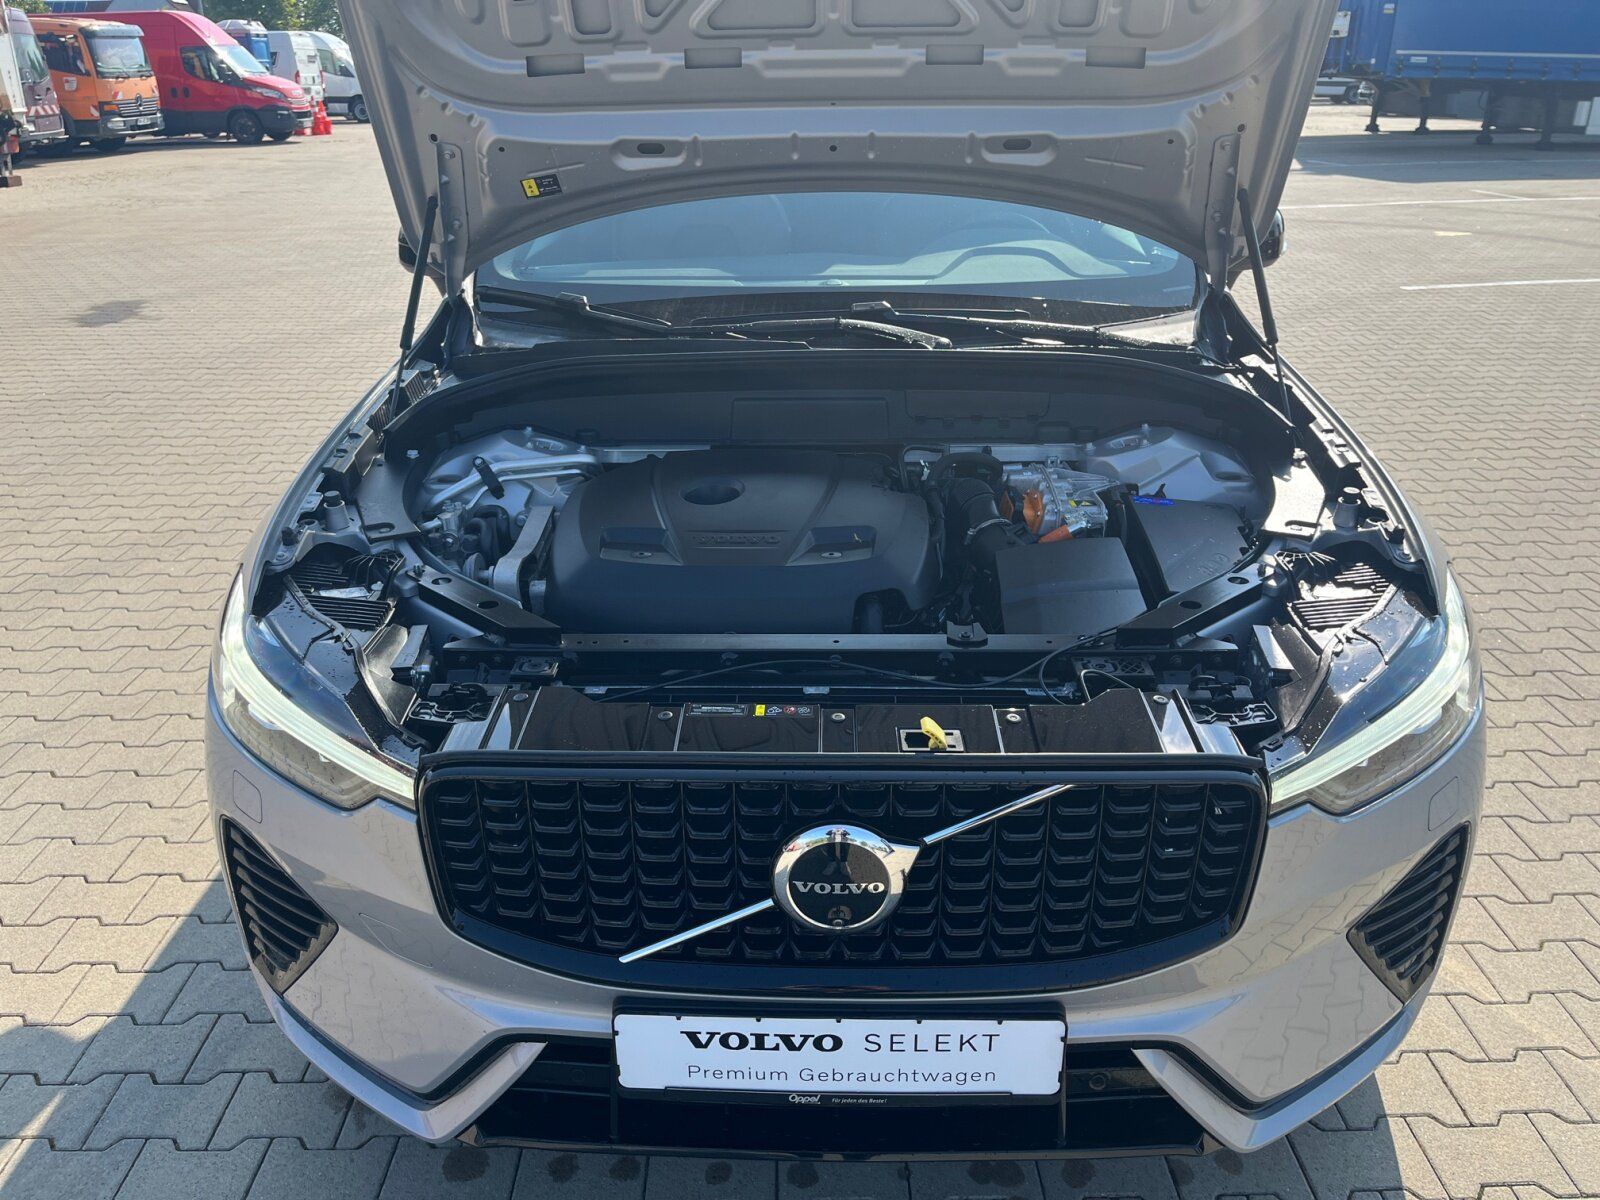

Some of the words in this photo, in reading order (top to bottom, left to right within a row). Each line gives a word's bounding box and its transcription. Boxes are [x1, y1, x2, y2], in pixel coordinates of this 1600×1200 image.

[793, 881, 885, 894] VOLVO
[680, 1031, 844, 1052] VOLVO
[864, 1033, 1000, 1053] SELEKT
[687, 1065, 788, 1081] Premium
[799, 1067, 997, 1086] Gebrauchtwagen
[789, 1094, 820, 1104] Oppel
